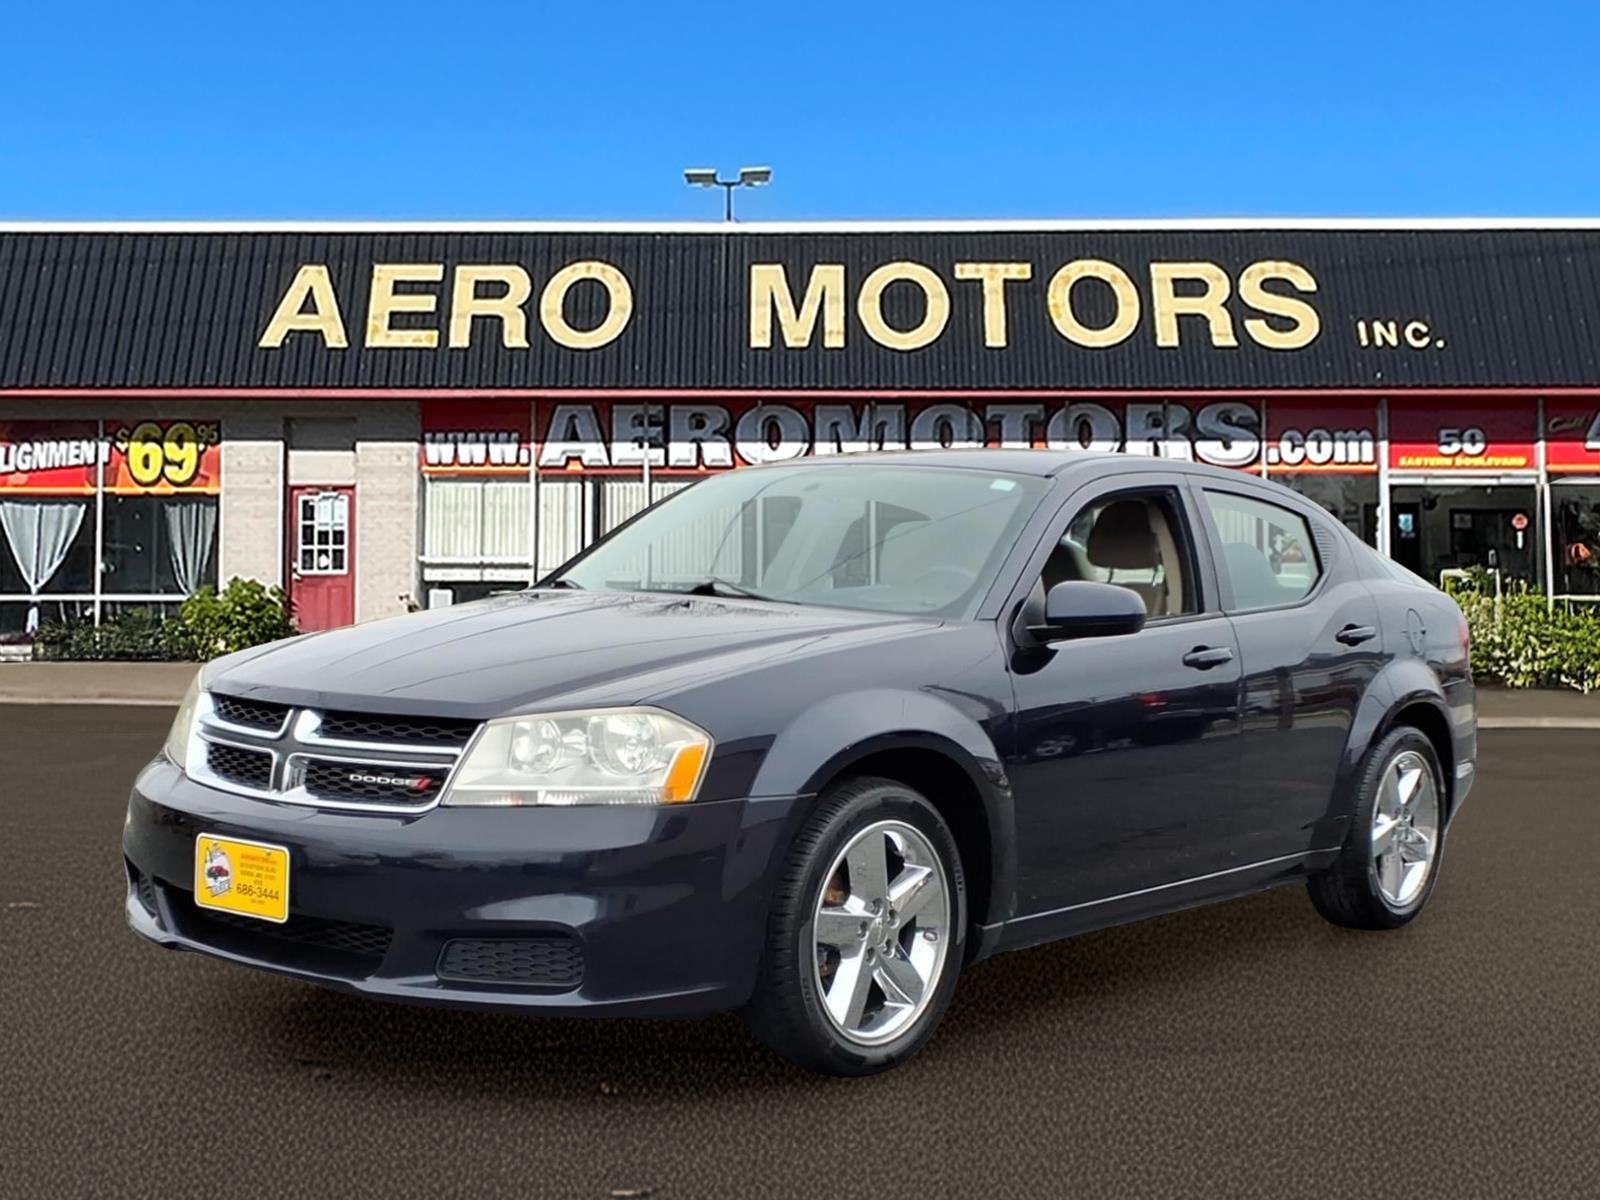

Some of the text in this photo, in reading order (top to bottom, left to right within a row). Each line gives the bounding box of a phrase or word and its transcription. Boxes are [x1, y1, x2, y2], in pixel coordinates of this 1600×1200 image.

[258, 259, 1447, 351] AERO MOTORS INC.
[1438, 428, 1486, 455] 50
[349, 773, 416, 787] DODGE
[236, 882, 280, 901] 686-3444
